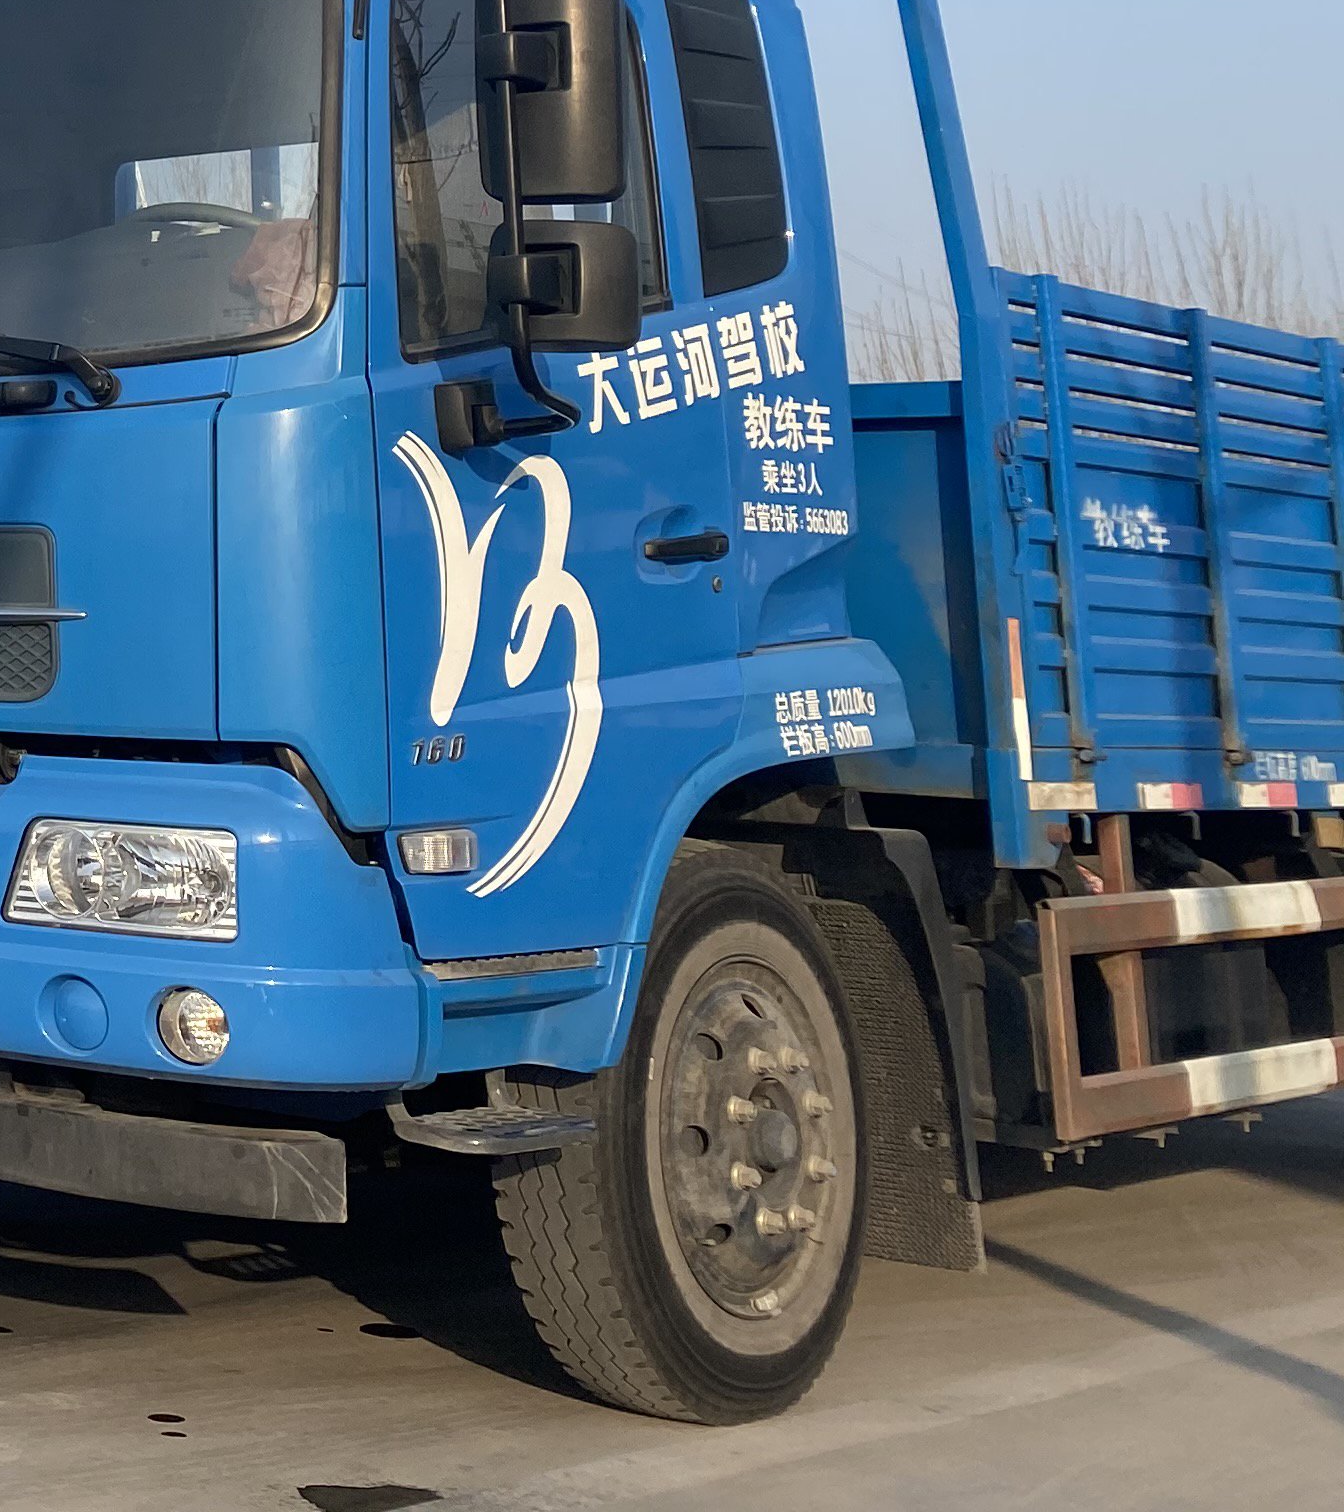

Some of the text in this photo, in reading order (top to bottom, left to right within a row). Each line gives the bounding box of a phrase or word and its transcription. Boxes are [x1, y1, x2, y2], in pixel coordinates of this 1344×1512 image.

[576, 300, 806, 435] 大运河驾校
[742, 391, 835, 454] 教练车
[762, 459, 824, 497] 乘坐3人
[774, 689, 823, 724] 总质量
[411, 732, 466, 766] 160
